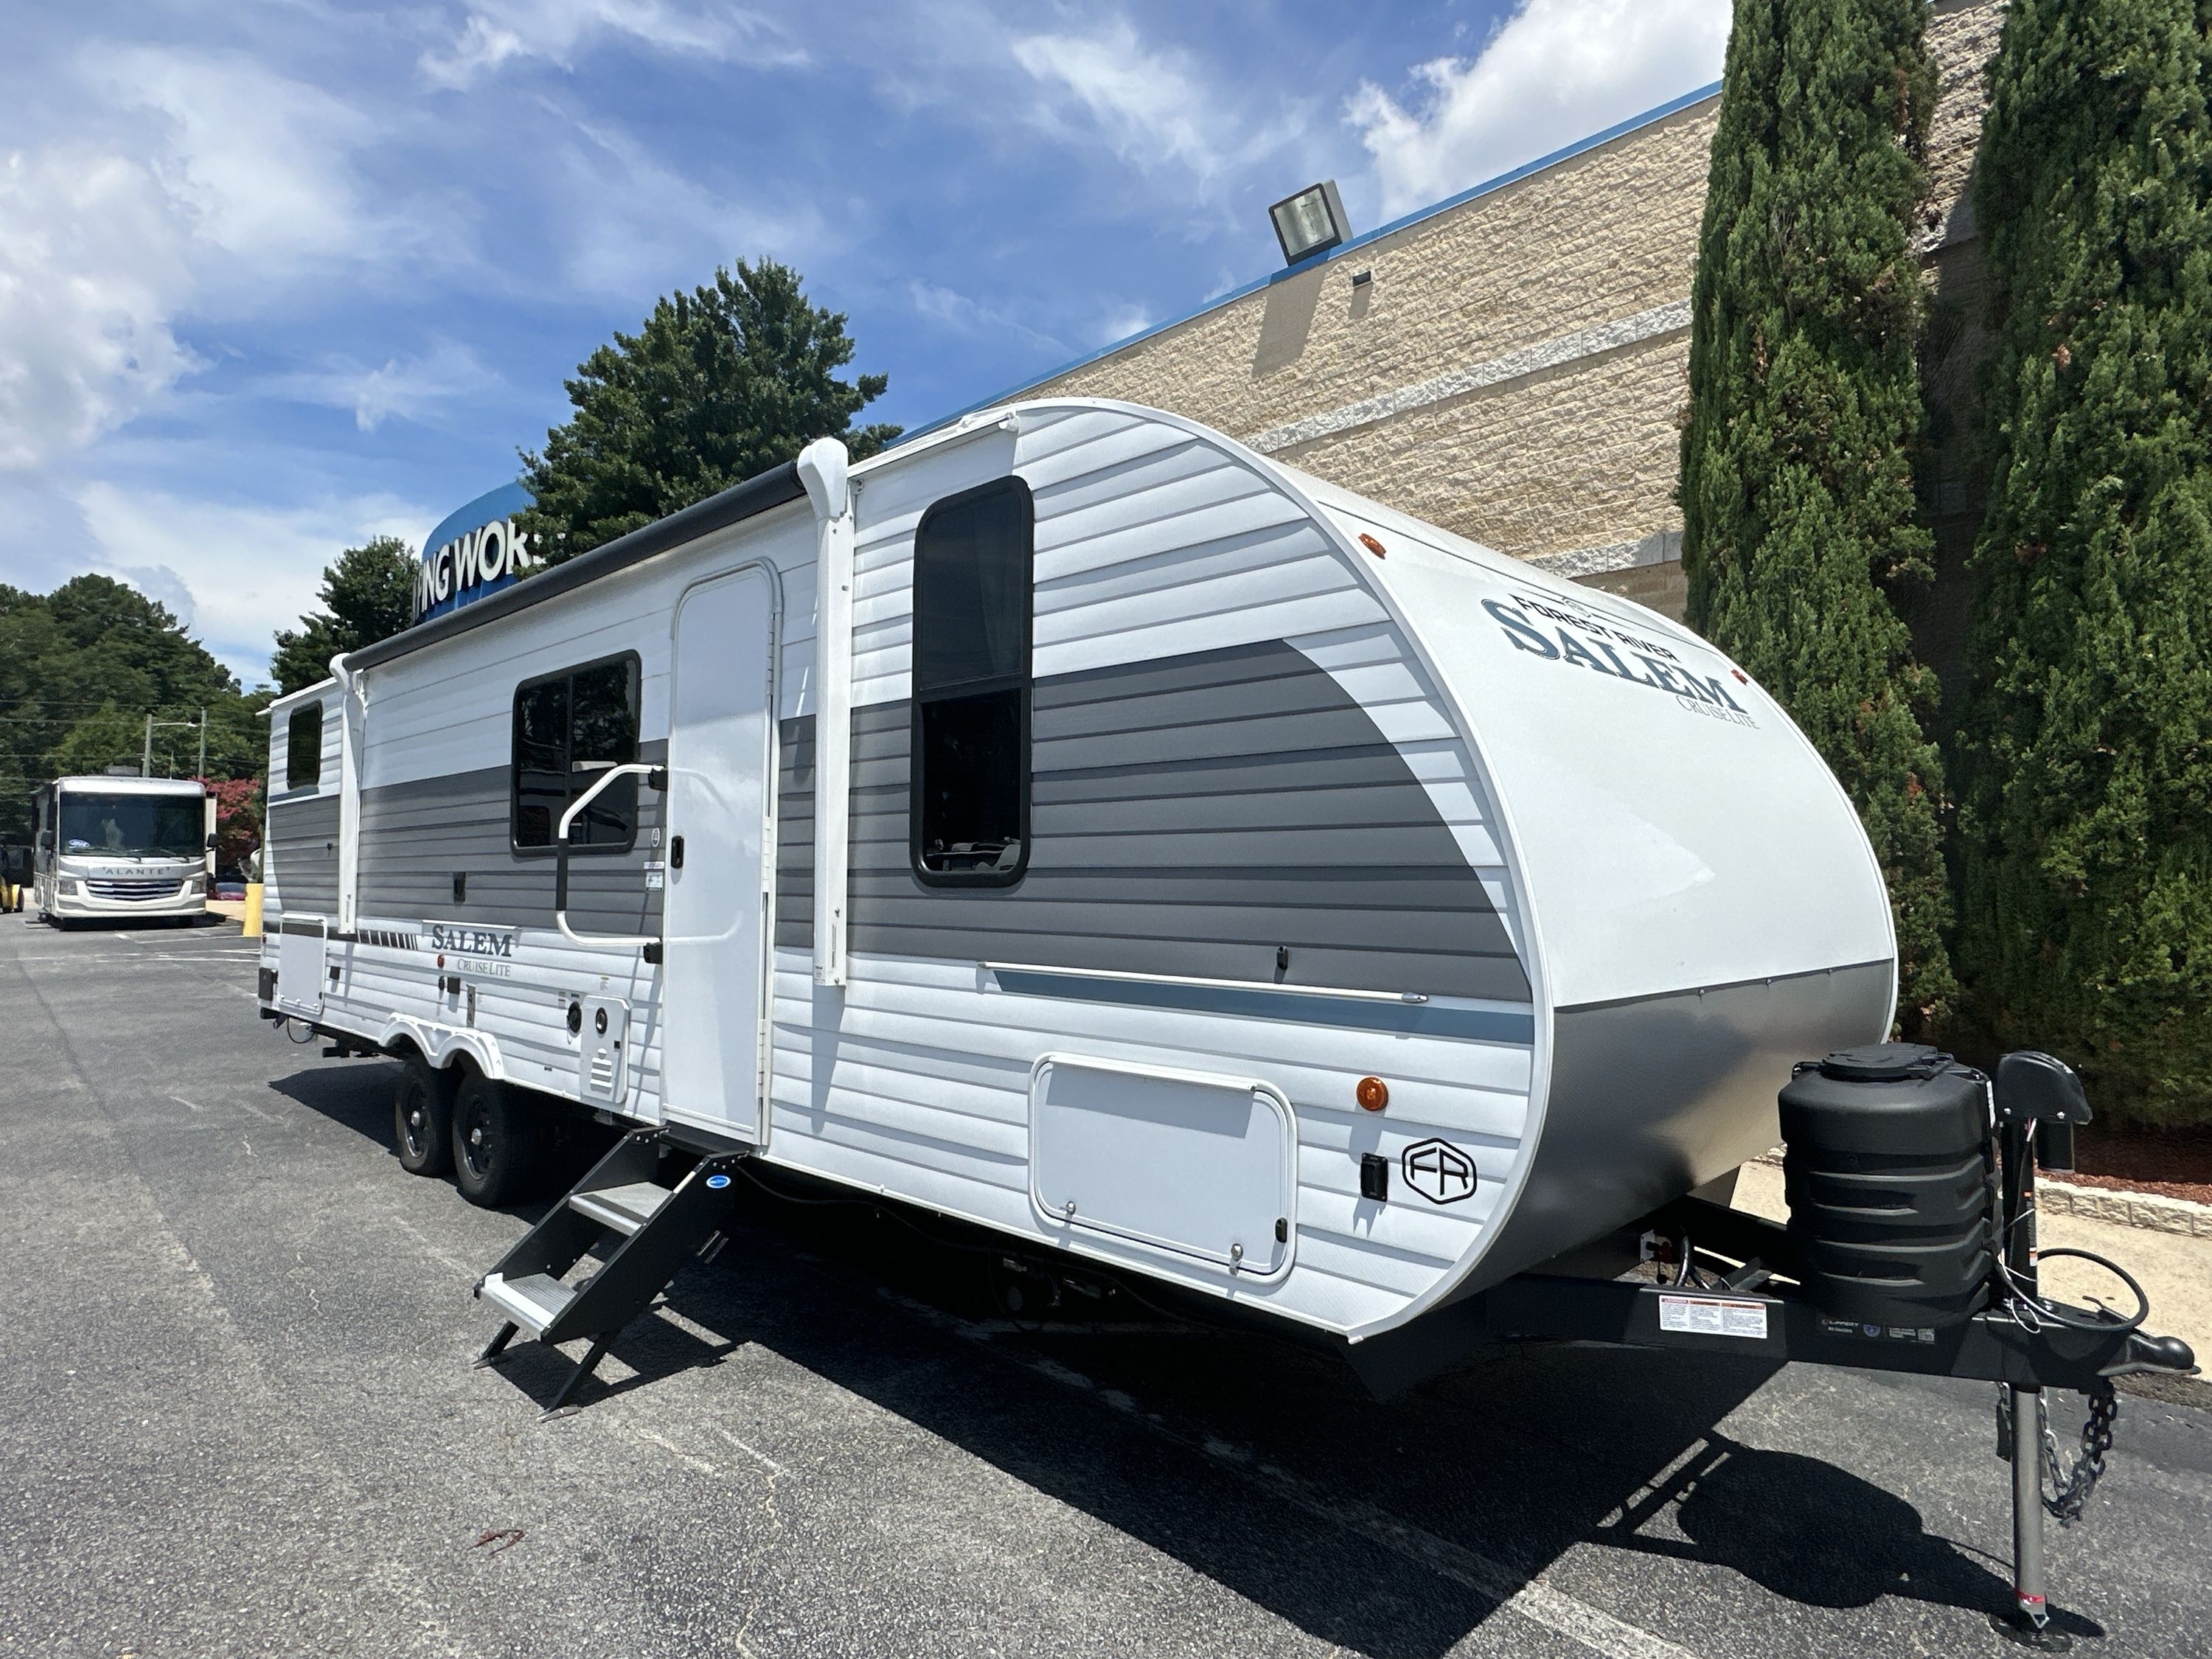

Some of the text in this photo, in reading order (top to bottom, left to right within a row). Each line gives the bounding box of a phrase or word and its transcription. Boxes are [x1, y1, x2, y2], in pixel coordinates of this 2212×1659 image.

[1481, 599, 1749, 714] SALEM
[1509, 593, 1614, 640] FOREST
[1610, 628, 1682, 664] RIVER
[431, 924, 512, 957] SALEM
